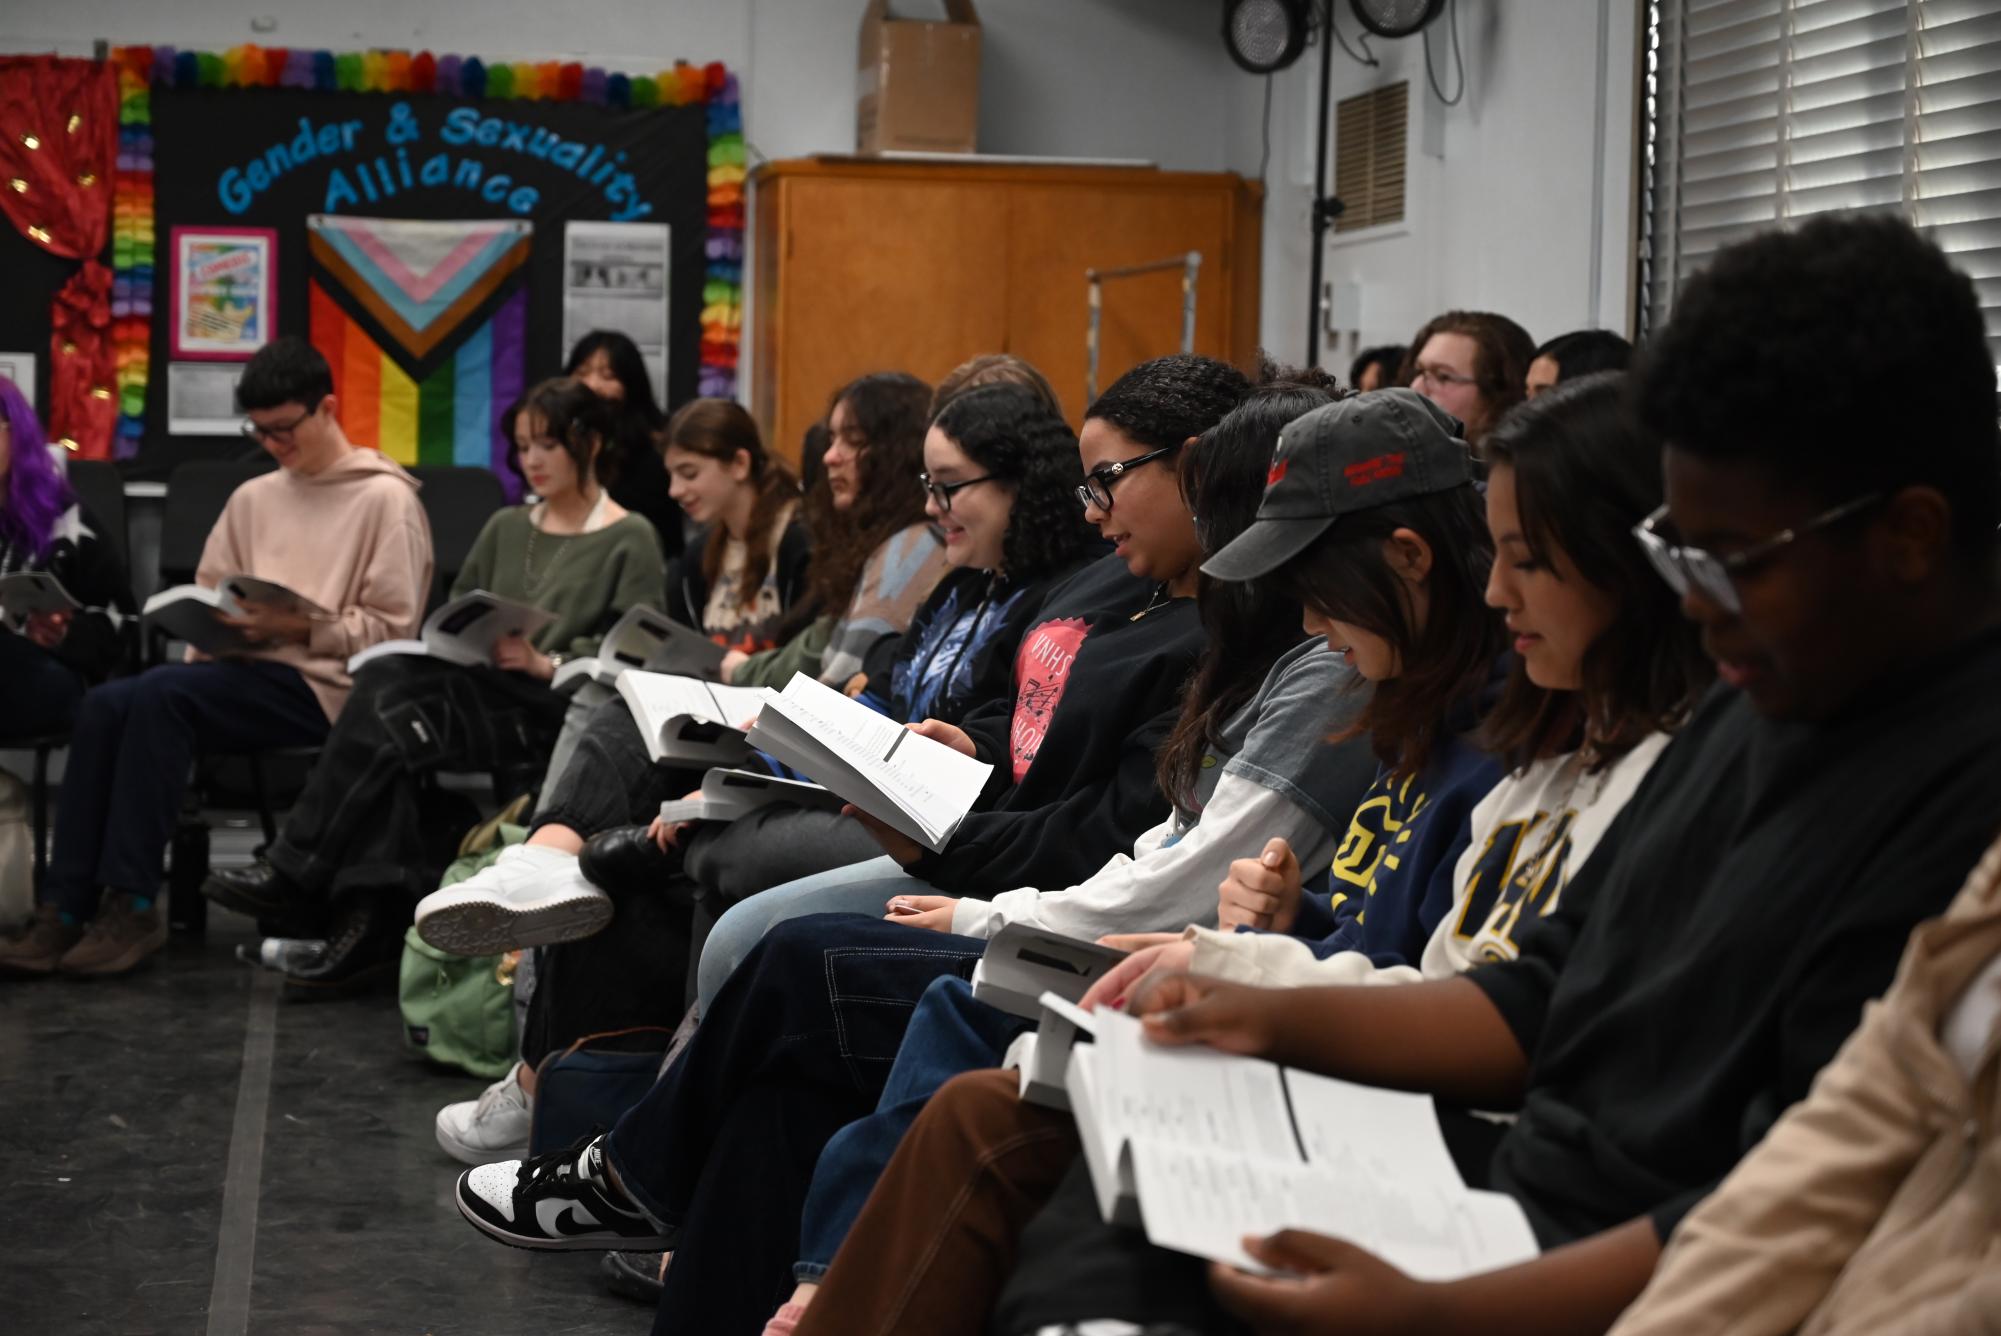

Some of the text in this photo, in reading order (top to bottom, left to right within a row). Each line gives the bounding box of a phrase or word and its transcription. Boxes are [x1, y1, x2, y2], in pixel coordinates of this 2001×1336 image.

[217, 101, 653, 223] Gender & Sexuality
[324, 147, 540, 215] Alliance
[1032, 632, 1073, 677] VNHS
[593, 1148, 604, 1167] NIKE
